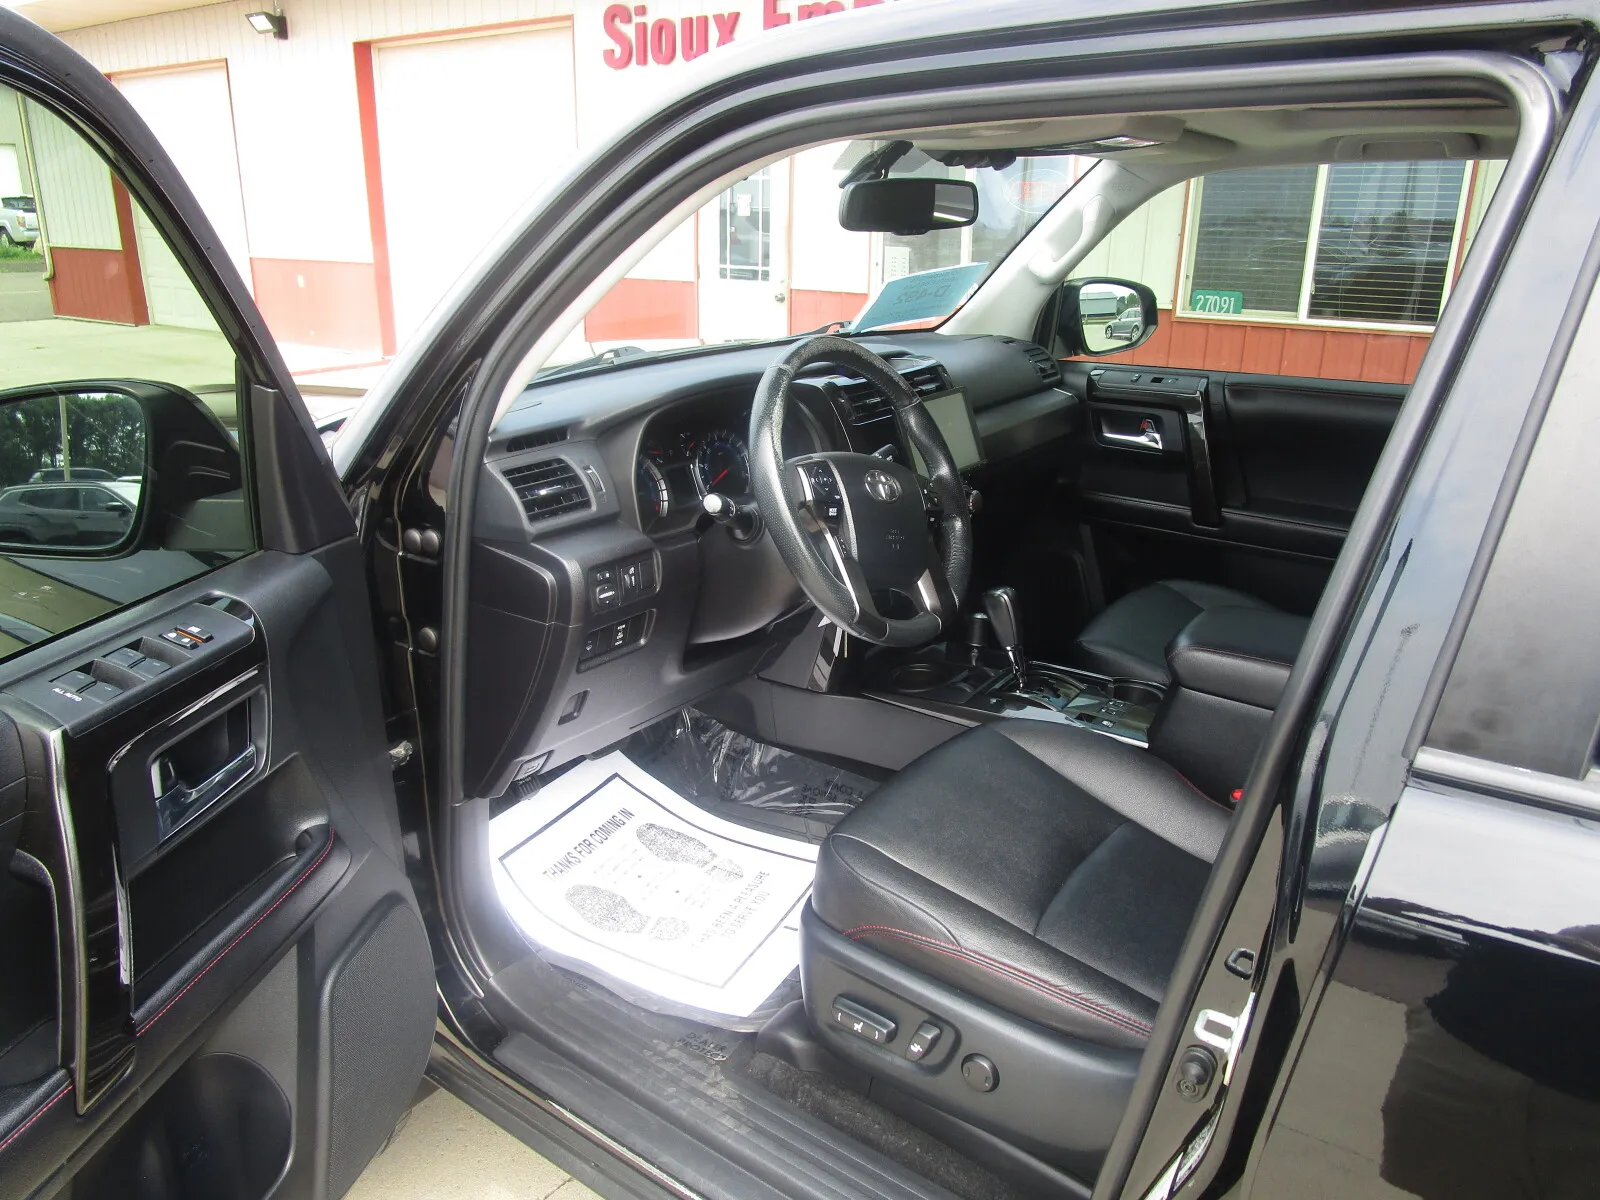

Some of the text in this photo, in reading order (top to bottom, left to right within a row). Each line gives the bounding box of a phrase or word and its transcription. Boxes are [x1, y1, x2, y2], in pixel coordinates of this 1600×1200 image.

[602, 3, 741, 70] Sioux
[1195, 295, 1235, 314] 27091
[542, 851, 582, 882] THANKS
[573, 838, 598, 858] FOR
[589, 814, 626, 844] COMING
[617, 807, 635, 821] IN
